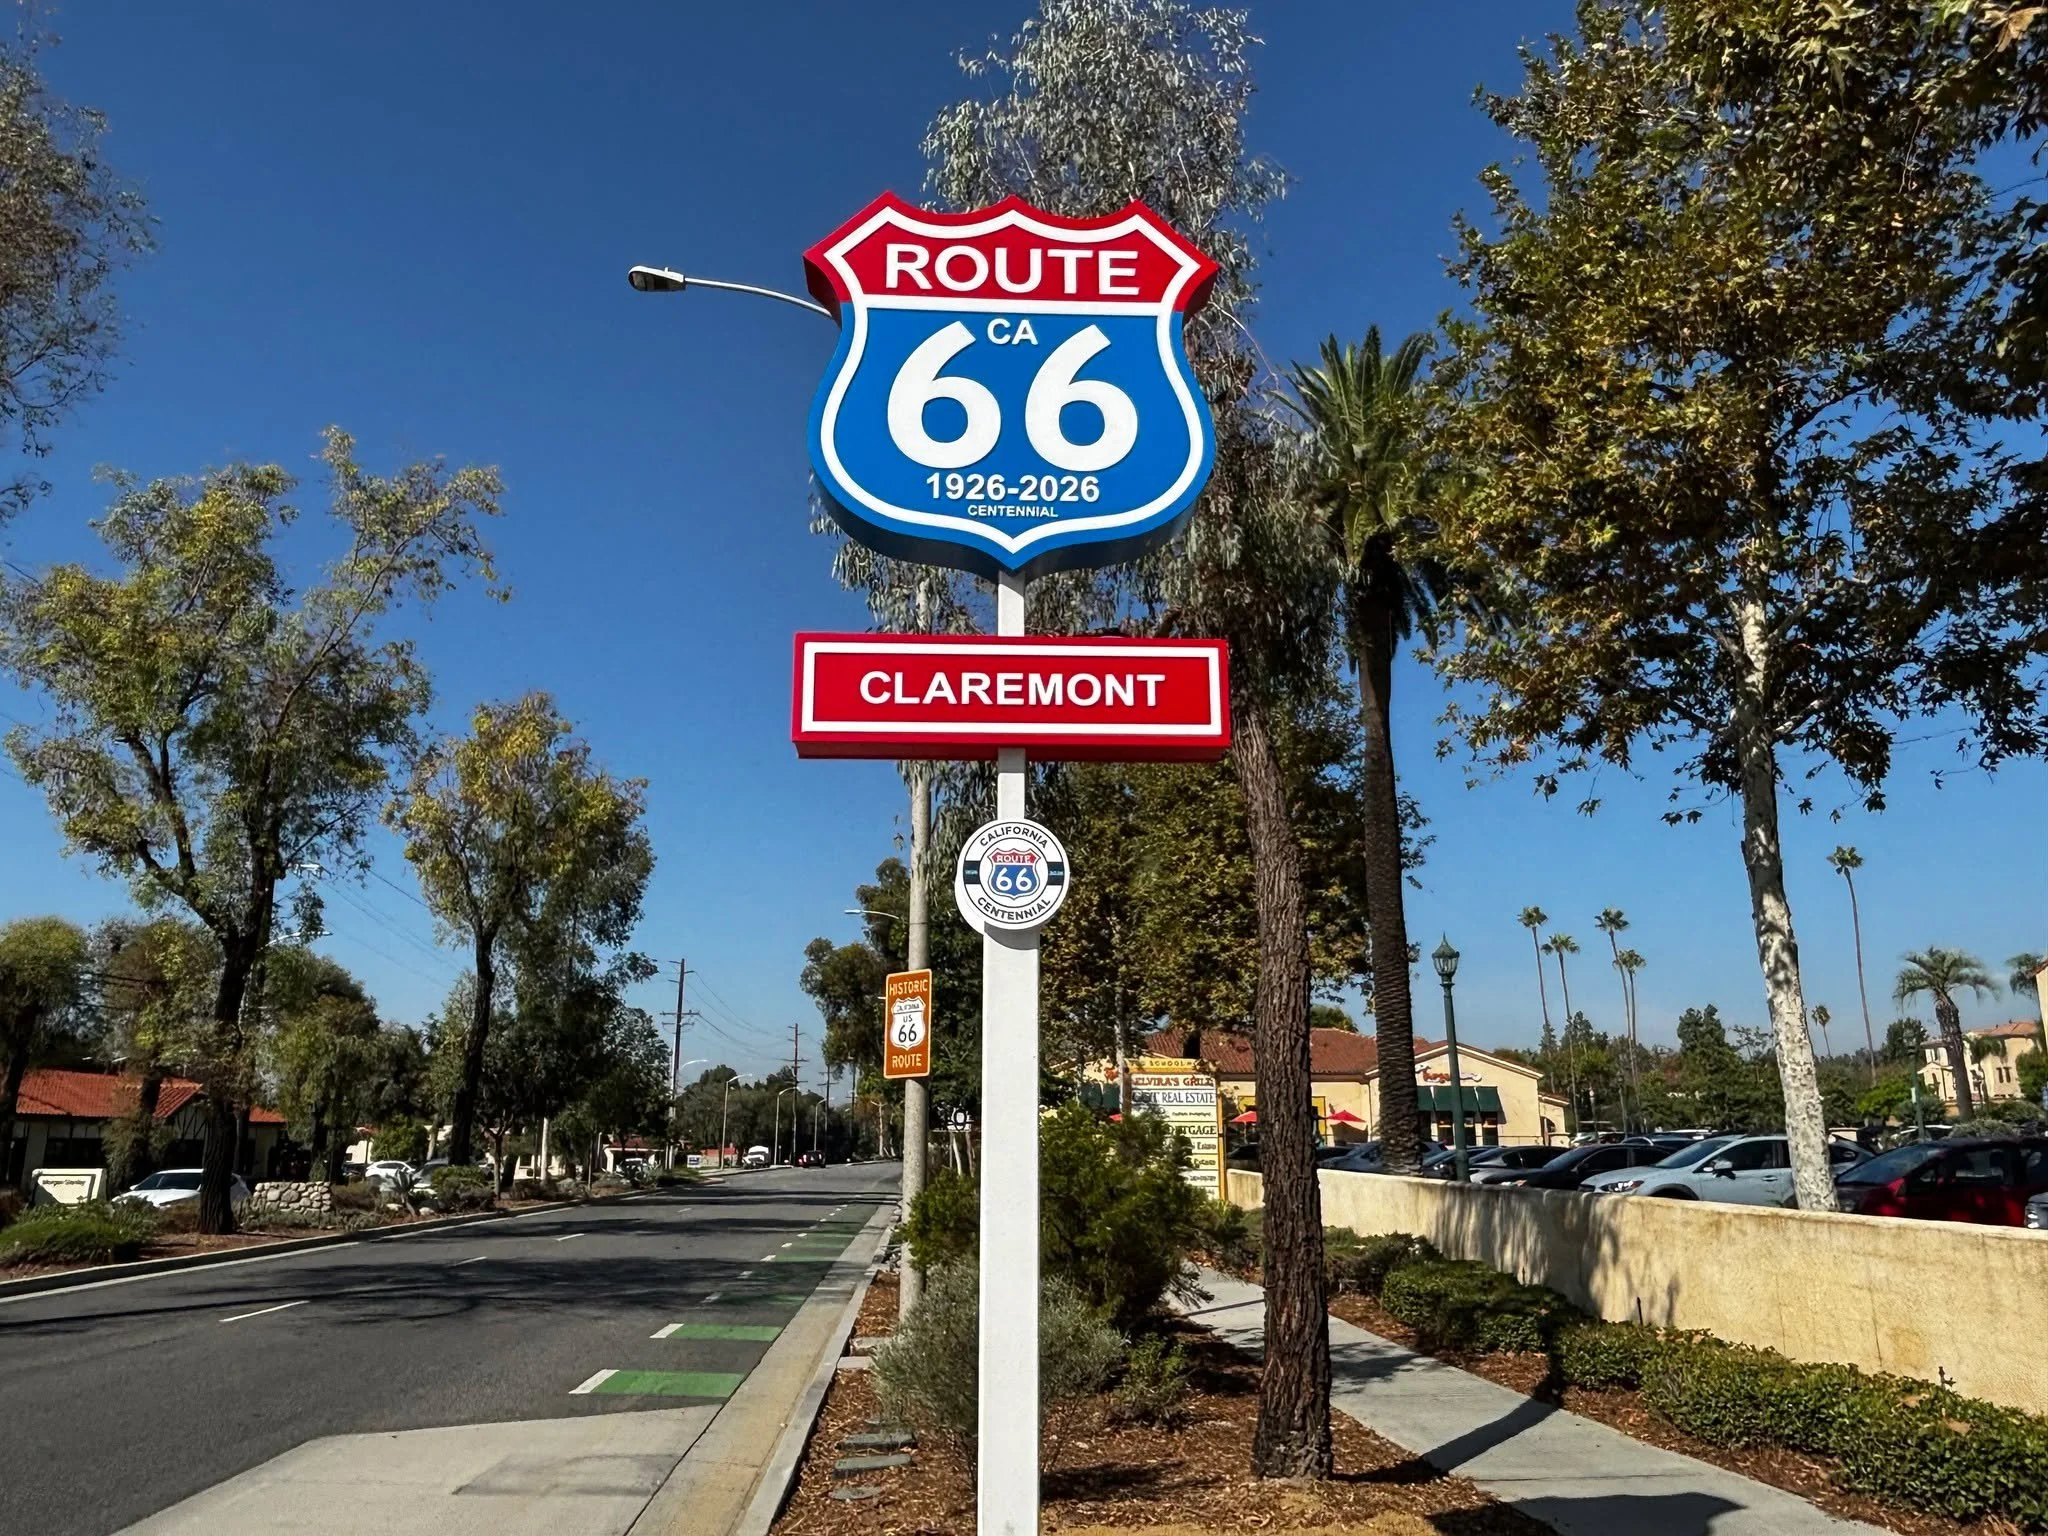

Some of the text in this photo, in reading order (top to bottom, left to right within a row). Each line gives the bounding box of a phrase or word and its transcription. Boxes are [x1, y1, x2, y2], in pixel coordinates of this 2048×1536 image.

[885, 243, 1140, 296] ROUTE
[987, 318, 1039, 346] CA
[887, 320, 1139, 472] 66
[926, 472, 1100, 502] 1926-2026
[967, 505, 1059, 518] CENTENNIAL
[859, 671, 1166, 707] CLAREMONT
[979, 826, 1048, 848] CALIFORNIA
[996, 854, 1031, 863] ROUTE
[995, 867, 1033, 891] 66
[977, 897, 1051, 920] CENTENNIAL
[889, 979, 929, 996] HISTORIC
[902, 1014, 913, 1023] US
[898, 1023, 917, 1043] 66
[892, 1053, 923, 1068] ROUTE
[1162, 1092, 1184, 1103] REAL
[1185, 1092, 1215, 1103] ESTATE
